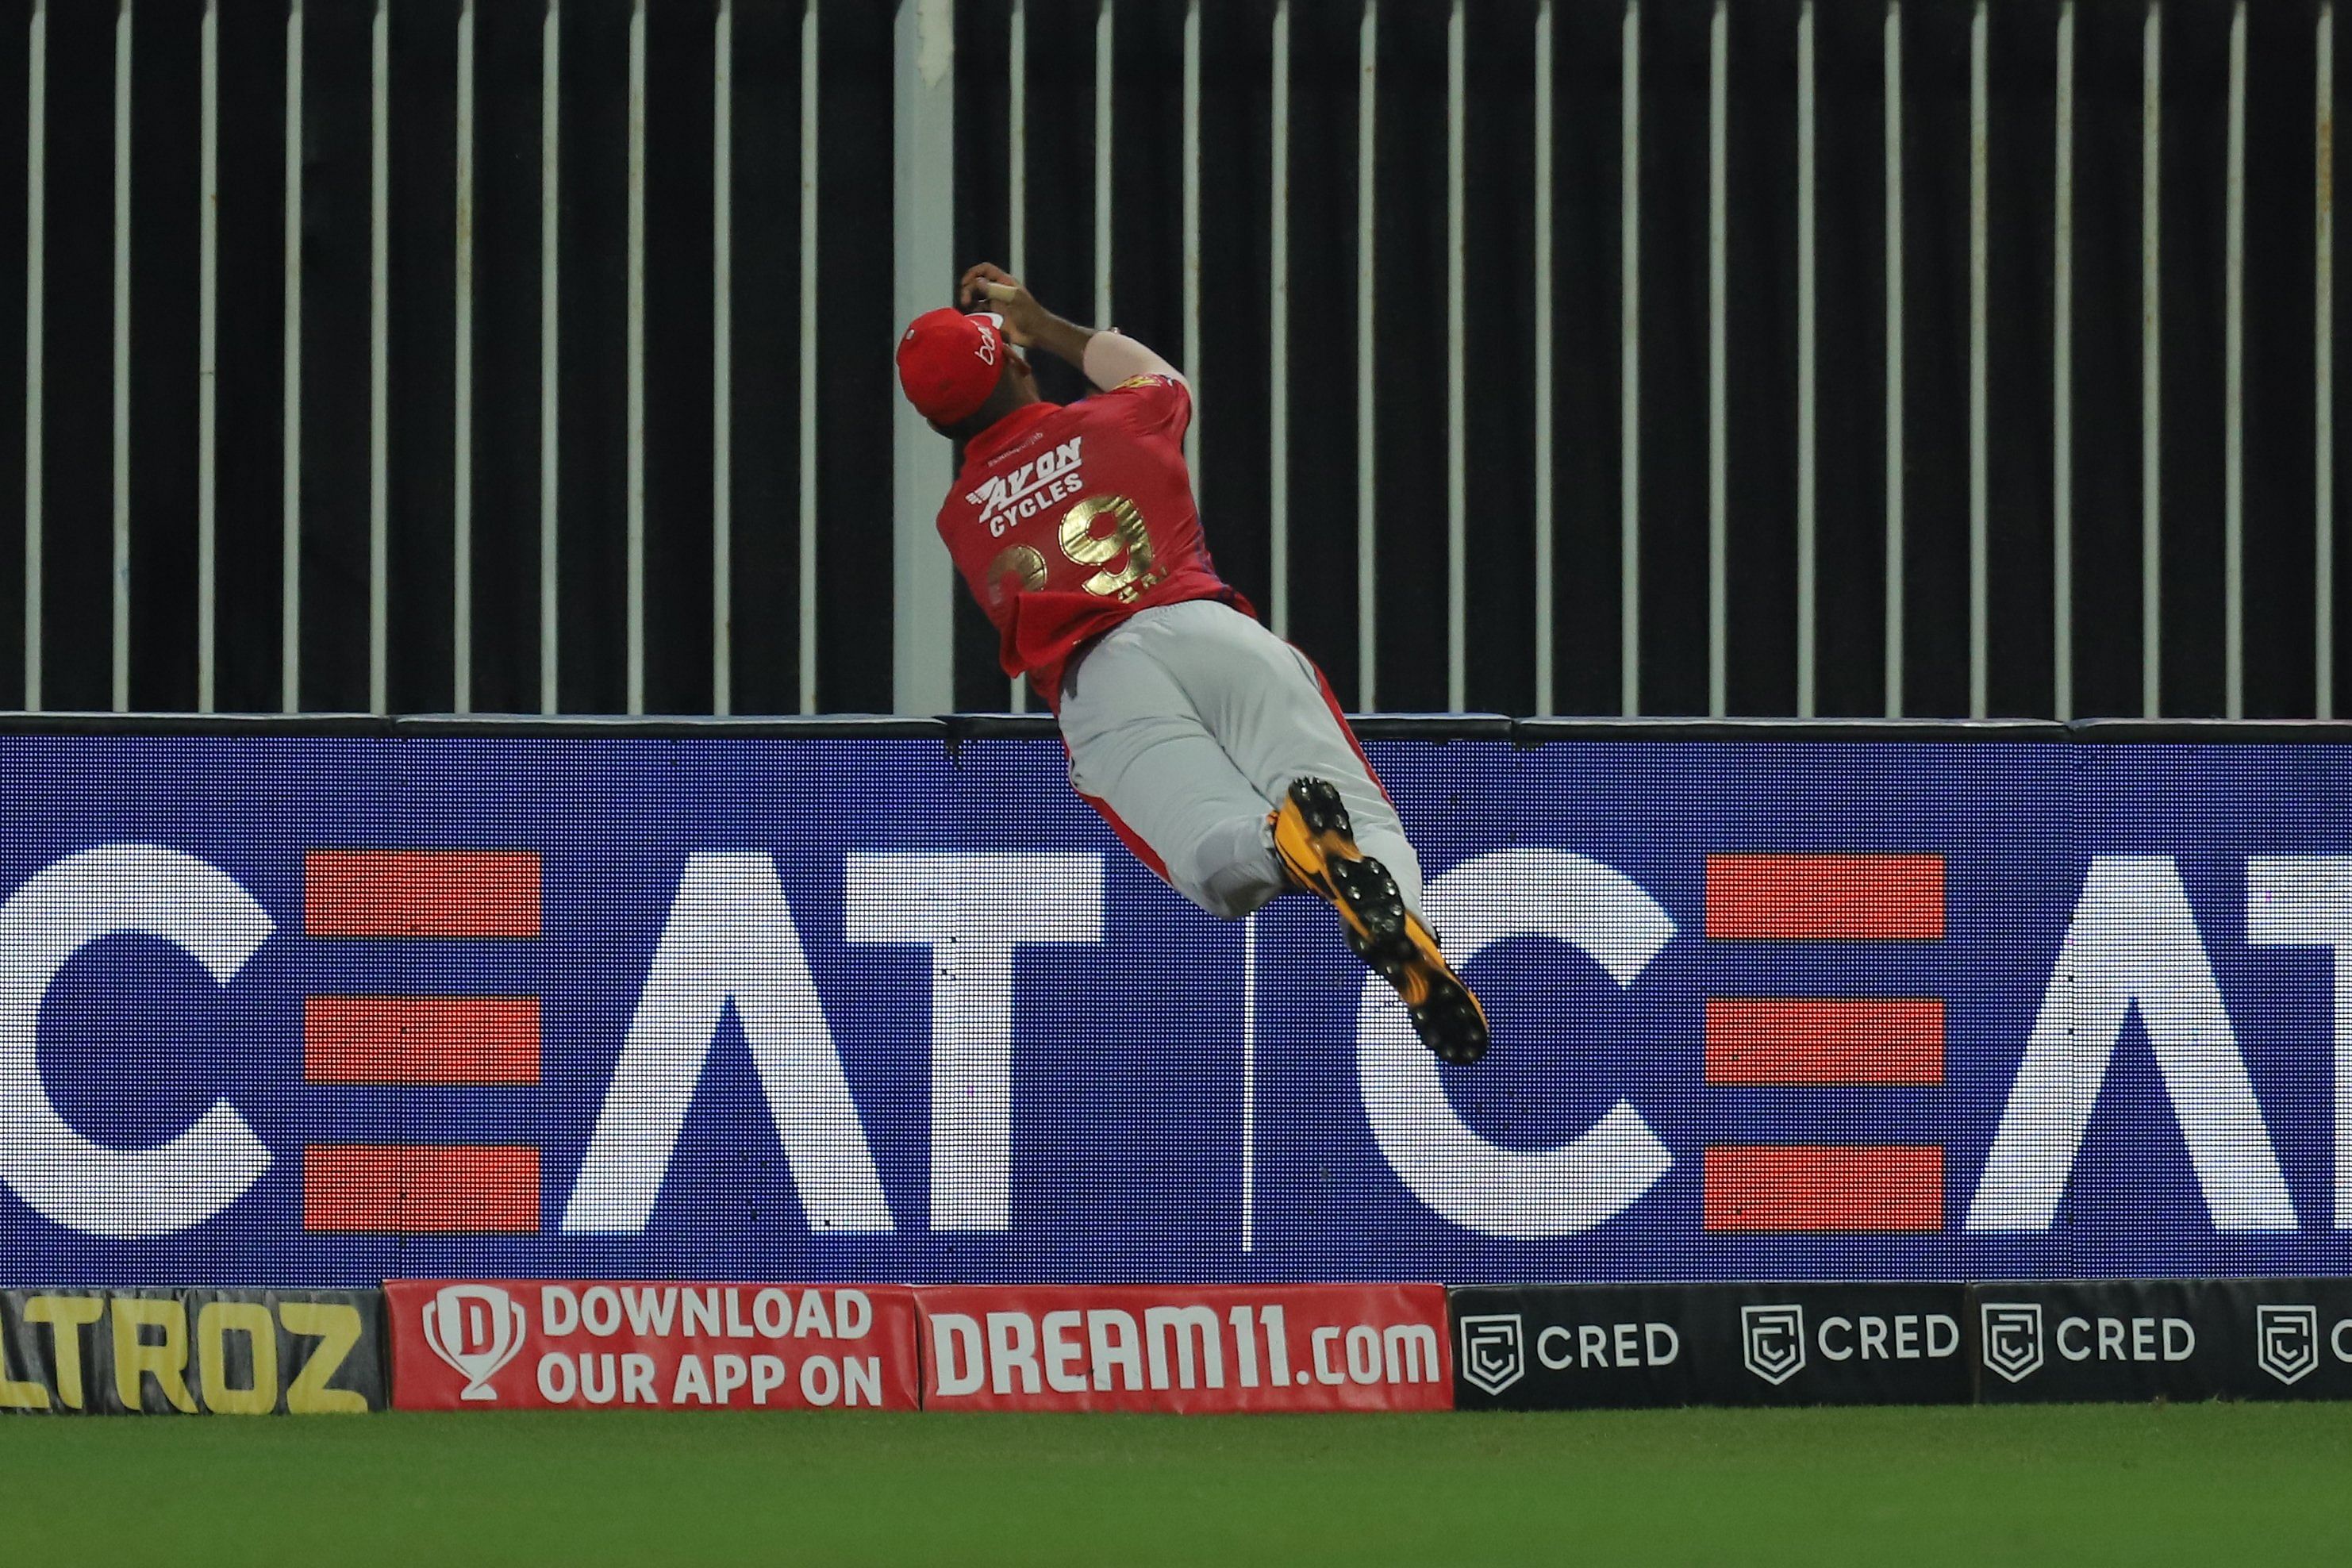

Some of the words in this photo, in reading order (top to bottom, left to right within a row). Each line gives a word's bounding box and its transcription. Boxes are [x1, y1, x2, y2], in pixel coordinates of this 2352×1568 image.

[966, 436, 1082, 524] AVON
[990, 473, 1083, 538] CYCLES
[0, 843, 1104, 1238] CEAT
[541, 1286, 872, 1339] DOWNLOAD
[1817, 1314, 1960, 1361] CRED
[2056, 1316, 2196, 1362] CRED
[928, 1304, 1440, 1397] DREAM11.com
[1536, 1323, 1680, 1370] CRED
[537, 1353, 658, 1405] OUR
[672, 1354, 786, 1405] APP
[800, 1356, 882, 1407] ON
